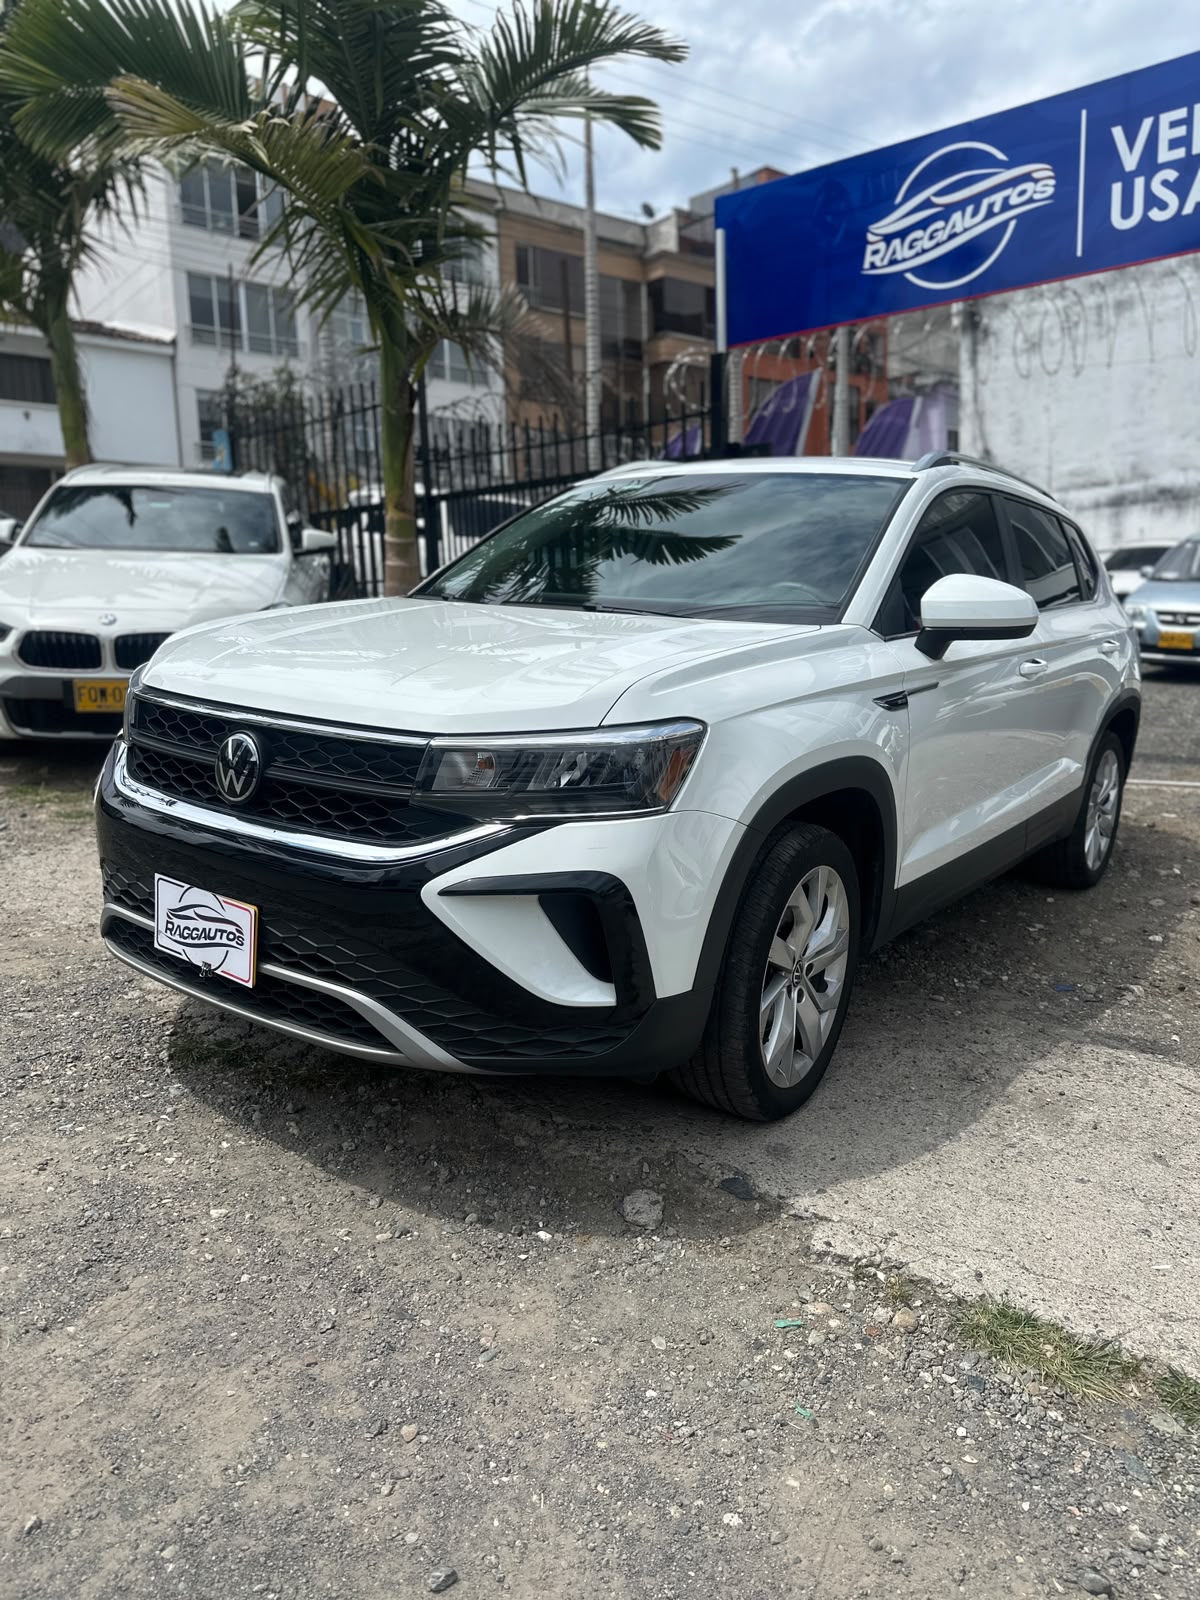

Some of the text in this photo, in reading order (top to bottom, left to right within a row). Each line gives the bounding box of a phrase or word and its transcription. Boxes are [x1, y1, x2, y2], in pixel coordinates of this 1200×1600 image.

[1111, 103, 1200, 172] VE
[863, 178, 1056, 269] RAGGAUTOS
[164, 919, 245, 947] RAGGAUTOS
